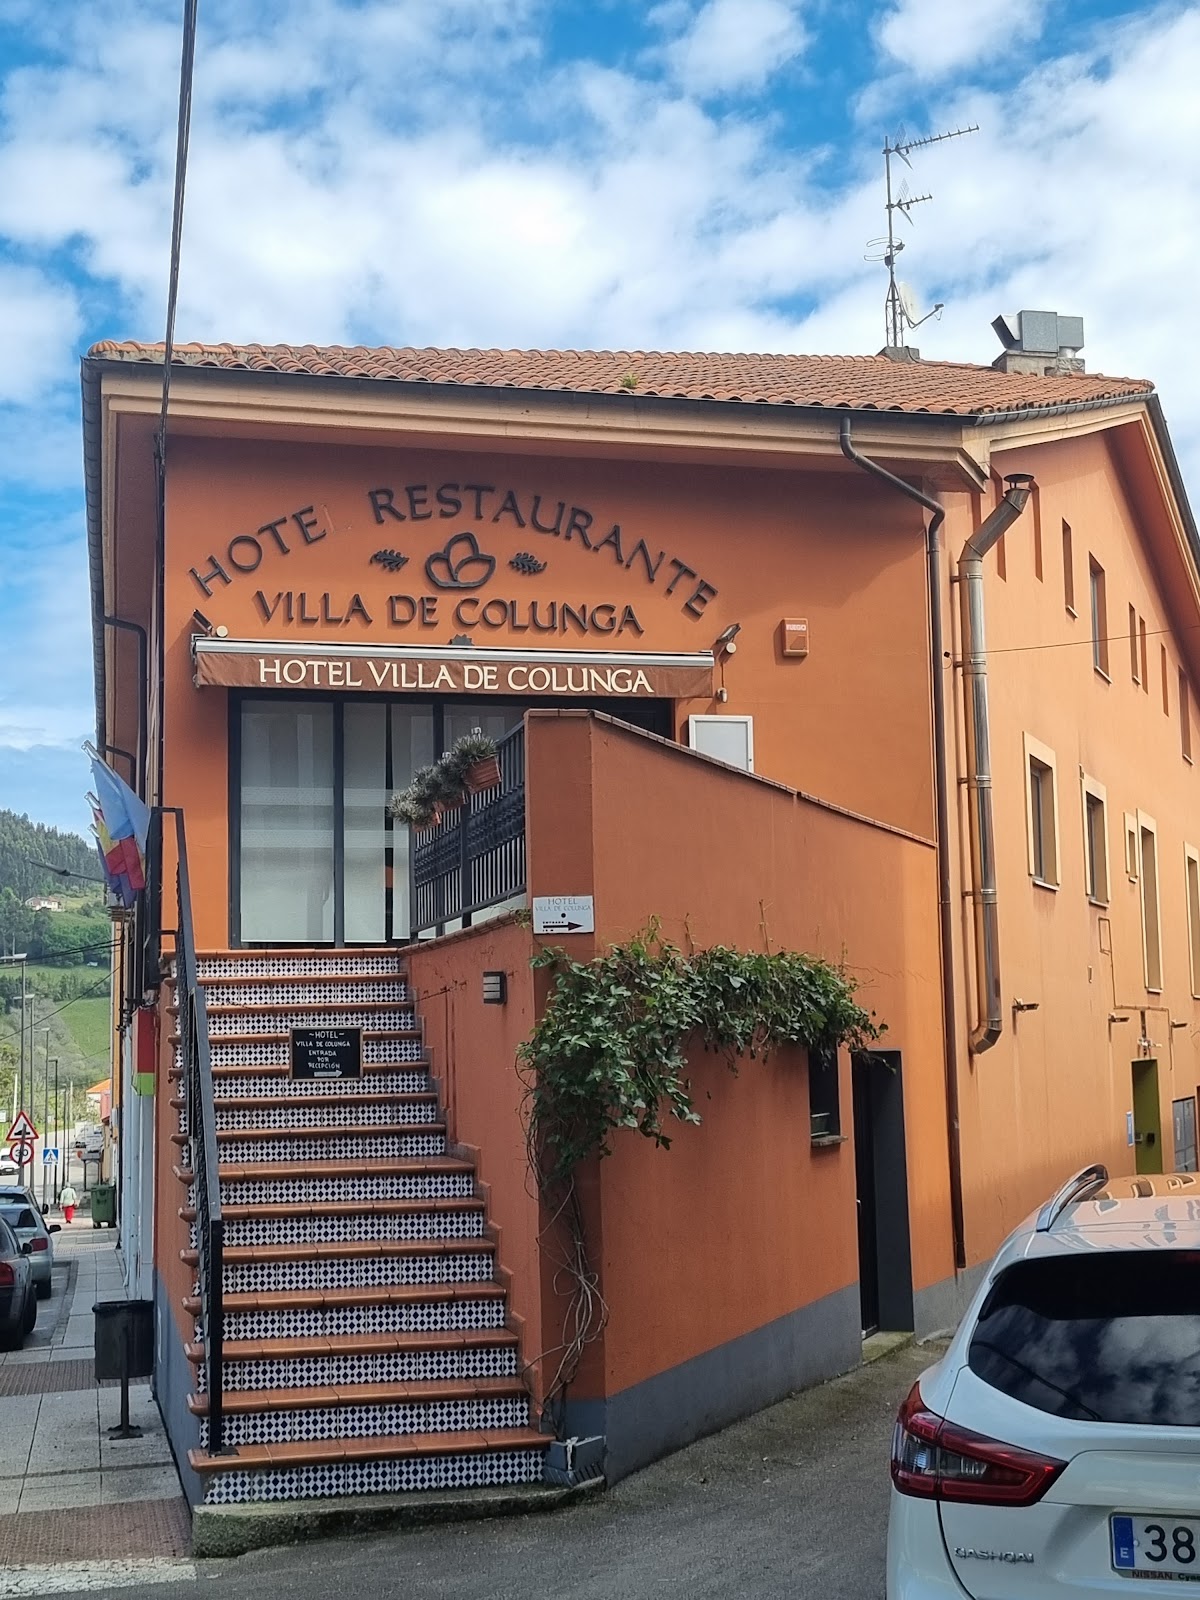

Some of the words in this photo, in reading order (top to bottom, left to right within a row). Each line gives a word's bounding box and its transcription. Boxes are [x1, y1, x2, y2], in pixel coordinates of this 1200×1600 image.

[368, 483, 718, 620] RESTAURANTE
[255, 590, 372, 626] VILLA
[388, 595, 438, 626] DE
[456, 597, 643, 635] COLUNGA
[258, 659, 362, 688] HOTEL
[367, 661, 458, 691] VILLA
[464, 665, 499, 691] DE
[507, 666, 654, 695] COLUNGA
[547, 897, 578, 905] HOTEL
[954, 1547, 1034, 1564] QASHQAI
[1120, 1548, 1129, 1558] E
[1144, 1525, 1196, 1564] 38
[1132, 1570, 1172, 1580] NISSAN
